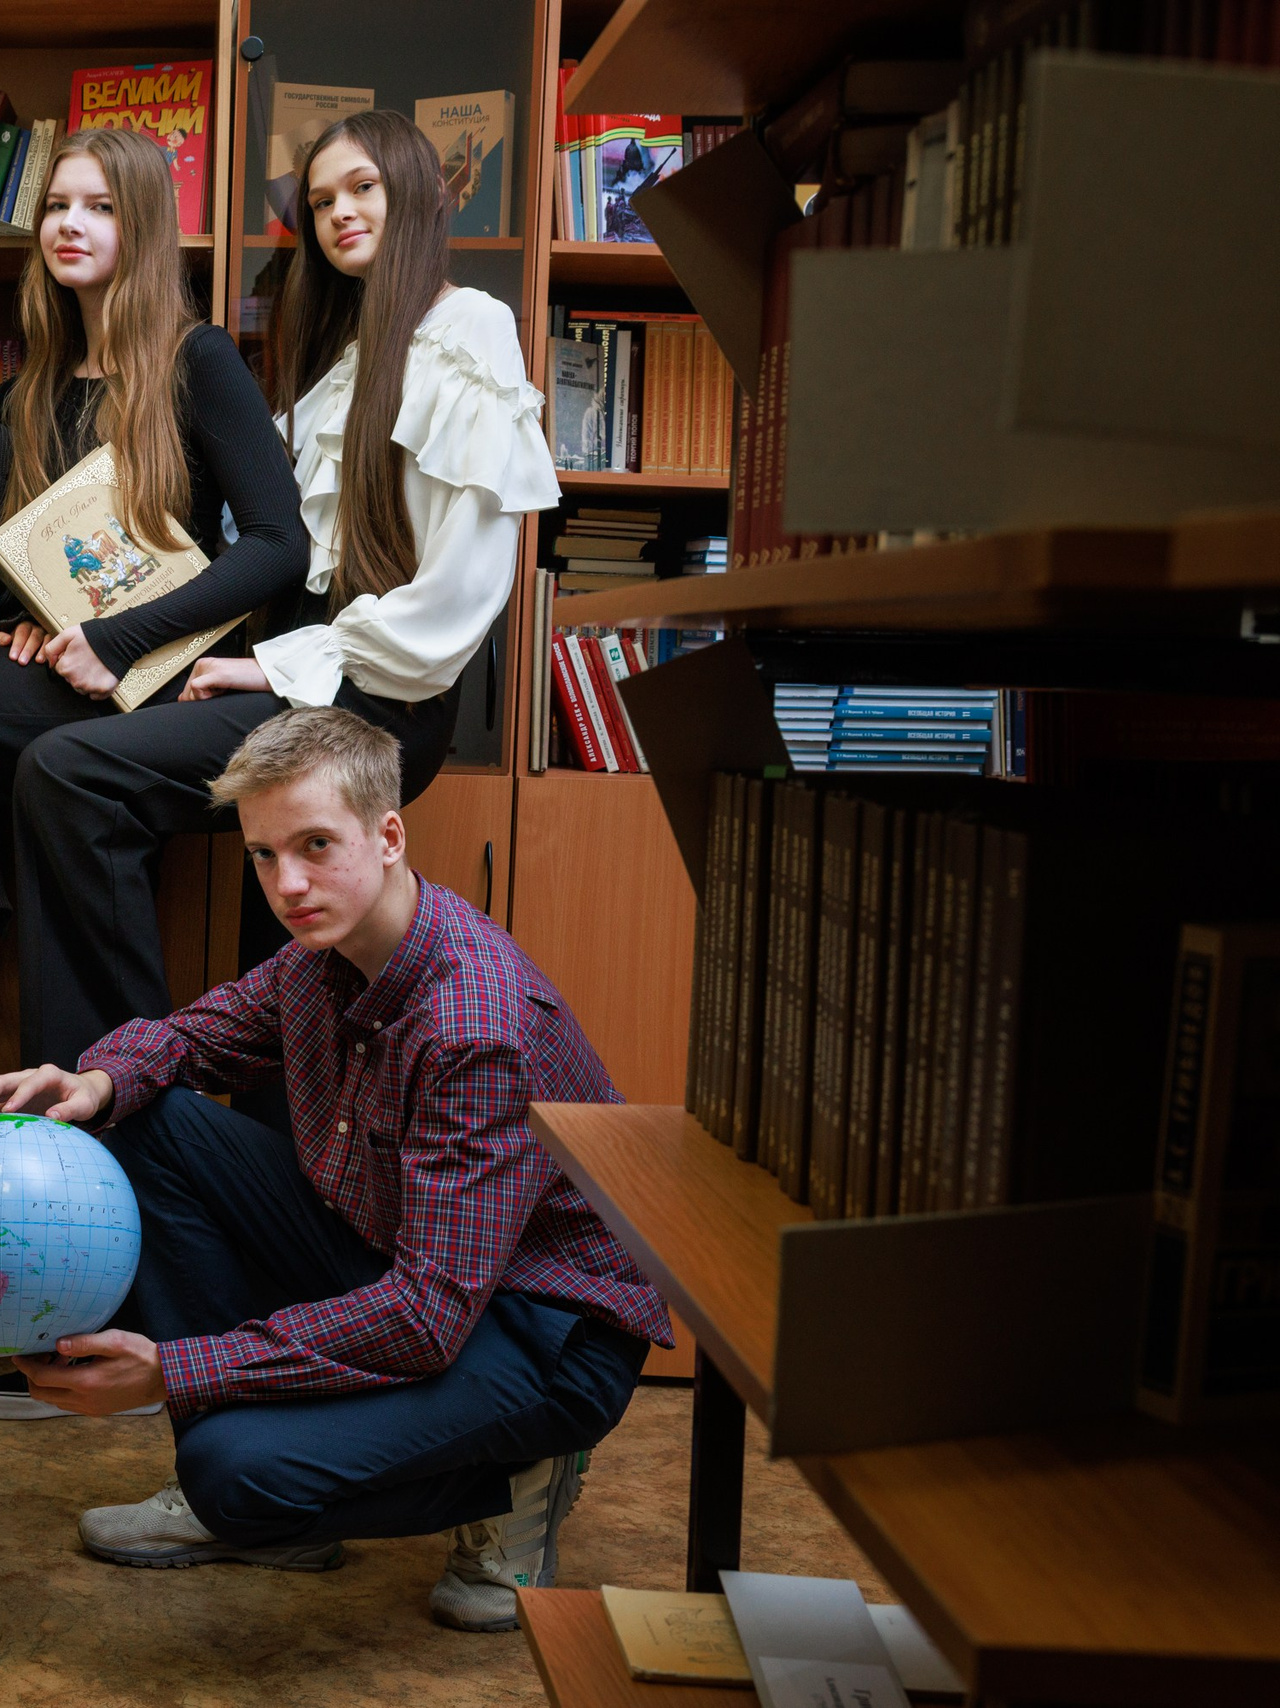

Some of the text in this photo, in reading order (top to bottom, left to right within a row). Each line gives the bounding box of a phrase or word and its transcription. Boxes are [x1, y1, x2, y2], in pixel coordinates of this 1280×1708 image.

[81, 67, 203, 112] ВЕЛИКИЙ
[284, 92, 371, 104] ГОСУДАРСТВЕННЫЕ СИМВОЛЫ
[315, 101, 339, 109] РОССИИ
[440, 103, 483, 119] НАША
[79, 101, 206, 137] МОГУЧИЙ
[432, 114, 490, 128] КОНСТИТУЦИЯ
[23, 152, 38, 186] СЛОВАРЬ
[69, 494, 98, 518] Даль
[573, 708, 584, 722] БЕК
[907, 709, 934, 718] ВСЕОБЩАЯ
[934, 710, 956, 718] ИСТОРИЯ
[578, 722, 598, 763] АЛЕКСАНДР
[907, 731, 934, 740] ВСЕОБЩАЯ
[934, 732, 956, 740] ИСТОРИЯ
